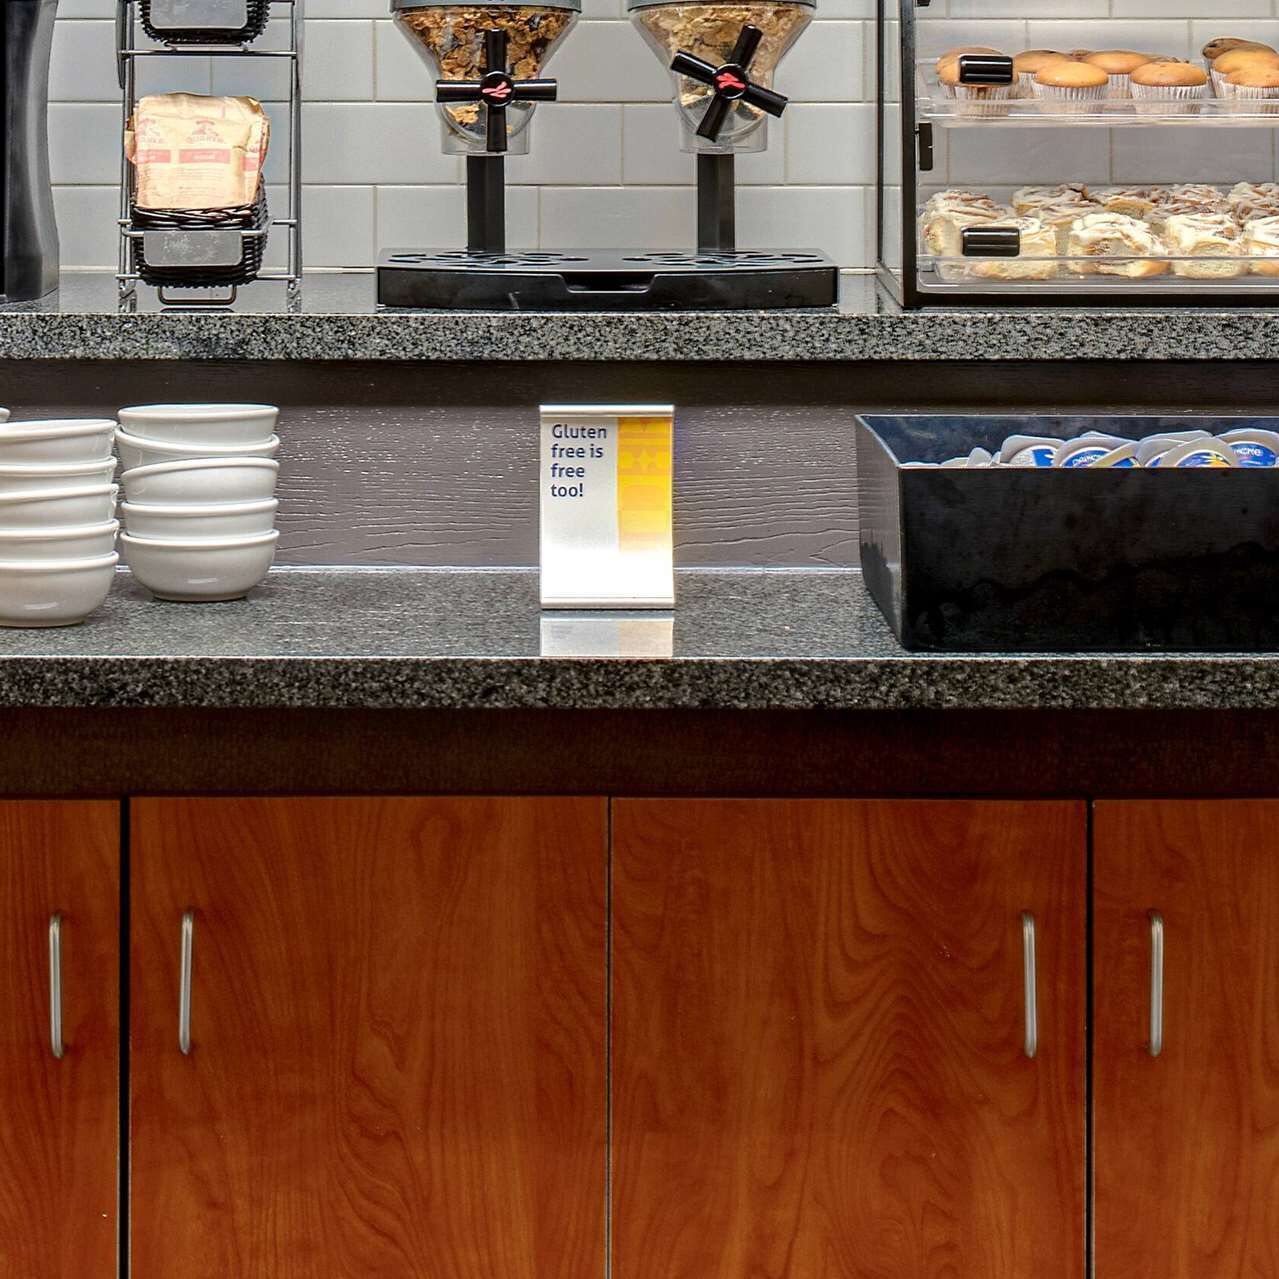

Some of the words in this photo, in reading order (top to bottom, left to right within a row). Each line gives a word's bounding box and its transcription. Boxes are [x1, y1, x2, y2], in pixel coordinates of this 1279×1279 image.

[551, 423, 608, 439] Gluten
[550, 443, 586, 459] free
[589, 443, 604, 459] is
[550, 462, 585, 478] free
[550, 482, 584, 498] too!
